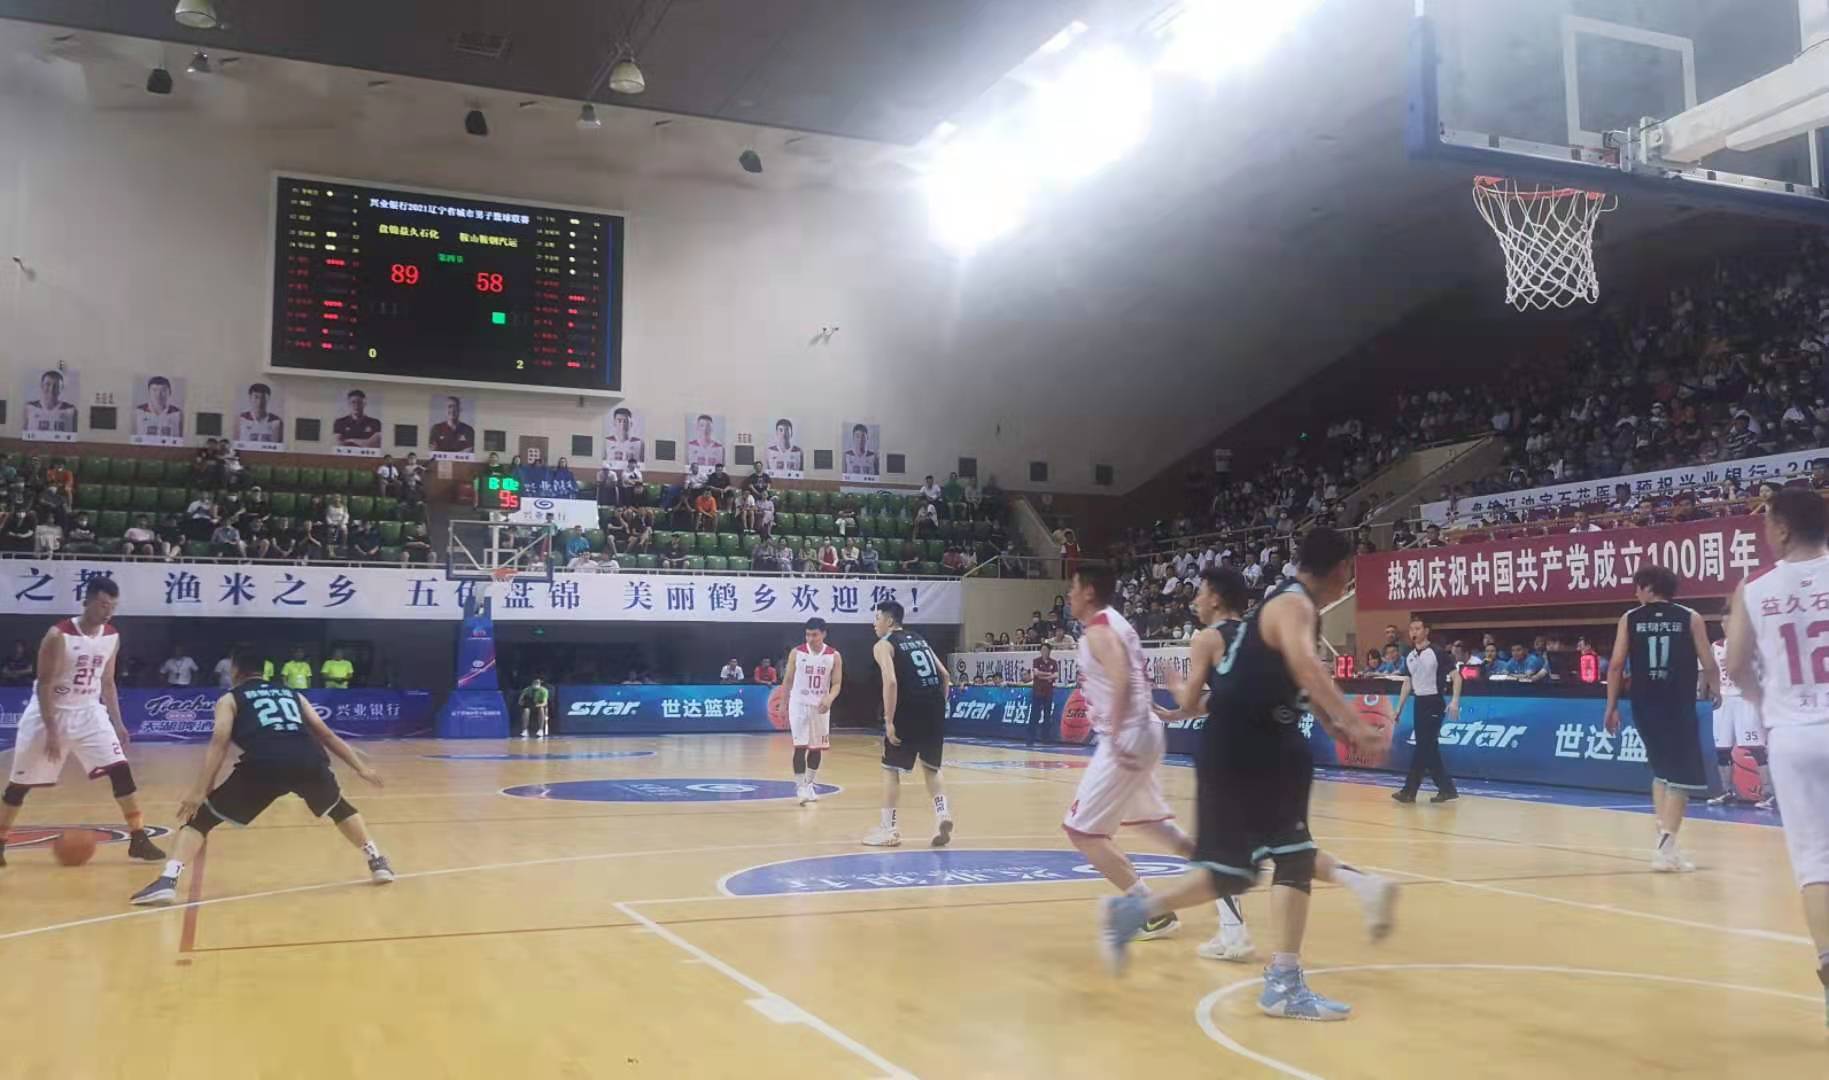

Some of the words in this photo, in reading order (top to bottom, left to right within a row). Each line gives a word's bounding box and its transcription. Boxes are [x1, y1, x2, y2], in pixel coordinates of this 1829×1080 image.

[391, 263, 419, 285] 89
[476, 272, 504, 293] 58
[368, 348, 377, 358] 0
[516, 359, 525, 369] 2
[1387, 529, 1760, 601] 热烈庆祝中国共产党成立100周年
[164, 571, 357, 608] 渔米之乡
[1648, 636, 1670, 668] 11
[1778, 619, 1829, 685] 12
[910, 649, 937, 678] 91
[1336, 656, 1354, 679] 22
[73, 668, 95, 686] 21
[808, 676, 821, 689] 10
[253, 698, 303, 727] 20
[335, 704, 400, 717] 兴业银行
[568, 700, 640, 716] star
[661, 699, 744, 718] 世达篮球
[952, 700, 996, 720] star
[1438, 720, 1528, 748] star
[1744, 731, 1758, 741] 35
